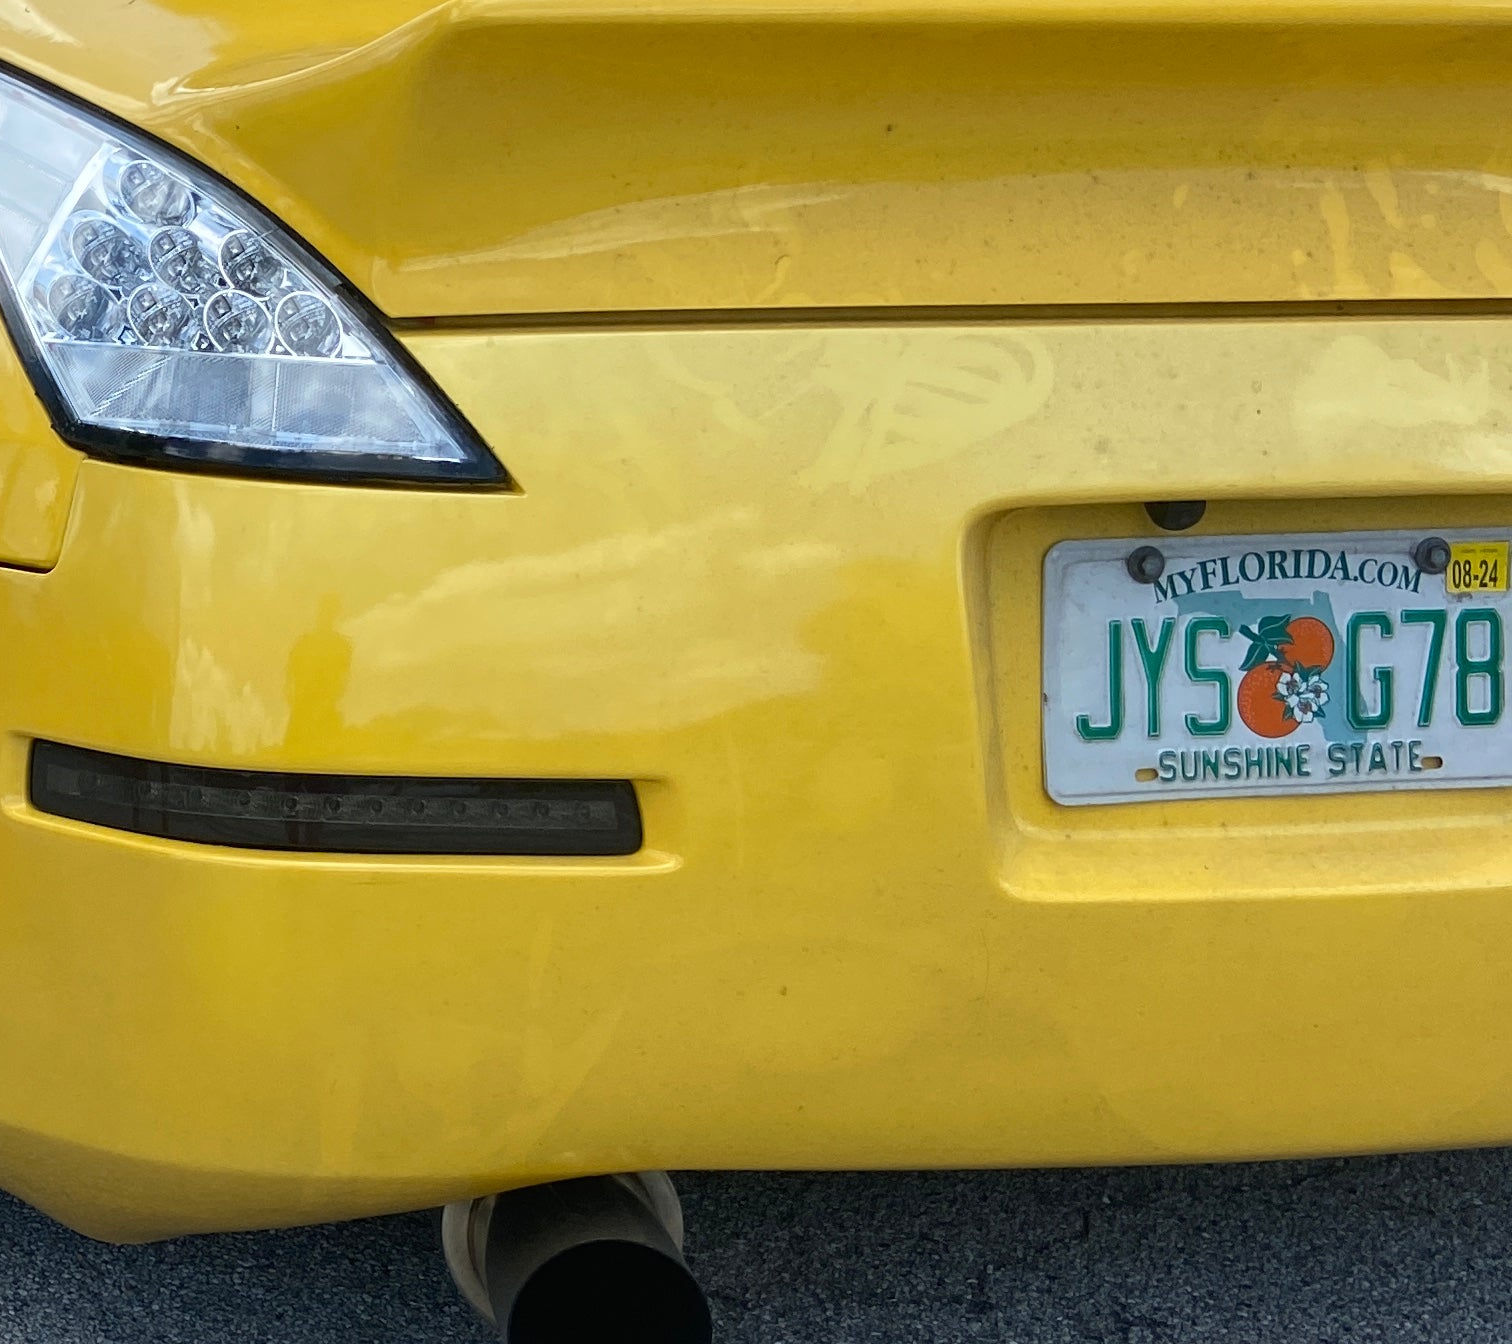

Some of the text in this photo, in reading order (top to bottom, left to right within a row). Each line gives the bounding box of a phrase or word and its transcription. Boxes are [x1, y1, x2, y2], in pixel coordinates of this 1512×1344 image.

[1154, 548, 1422, 604] MYFLORIDA.COM
[1452, 558, 1499, 589] 08-24
[1075, 607, 1505, 742] JYS G78
[1158, 740, 1424, 783] SUNSHINE STATE
